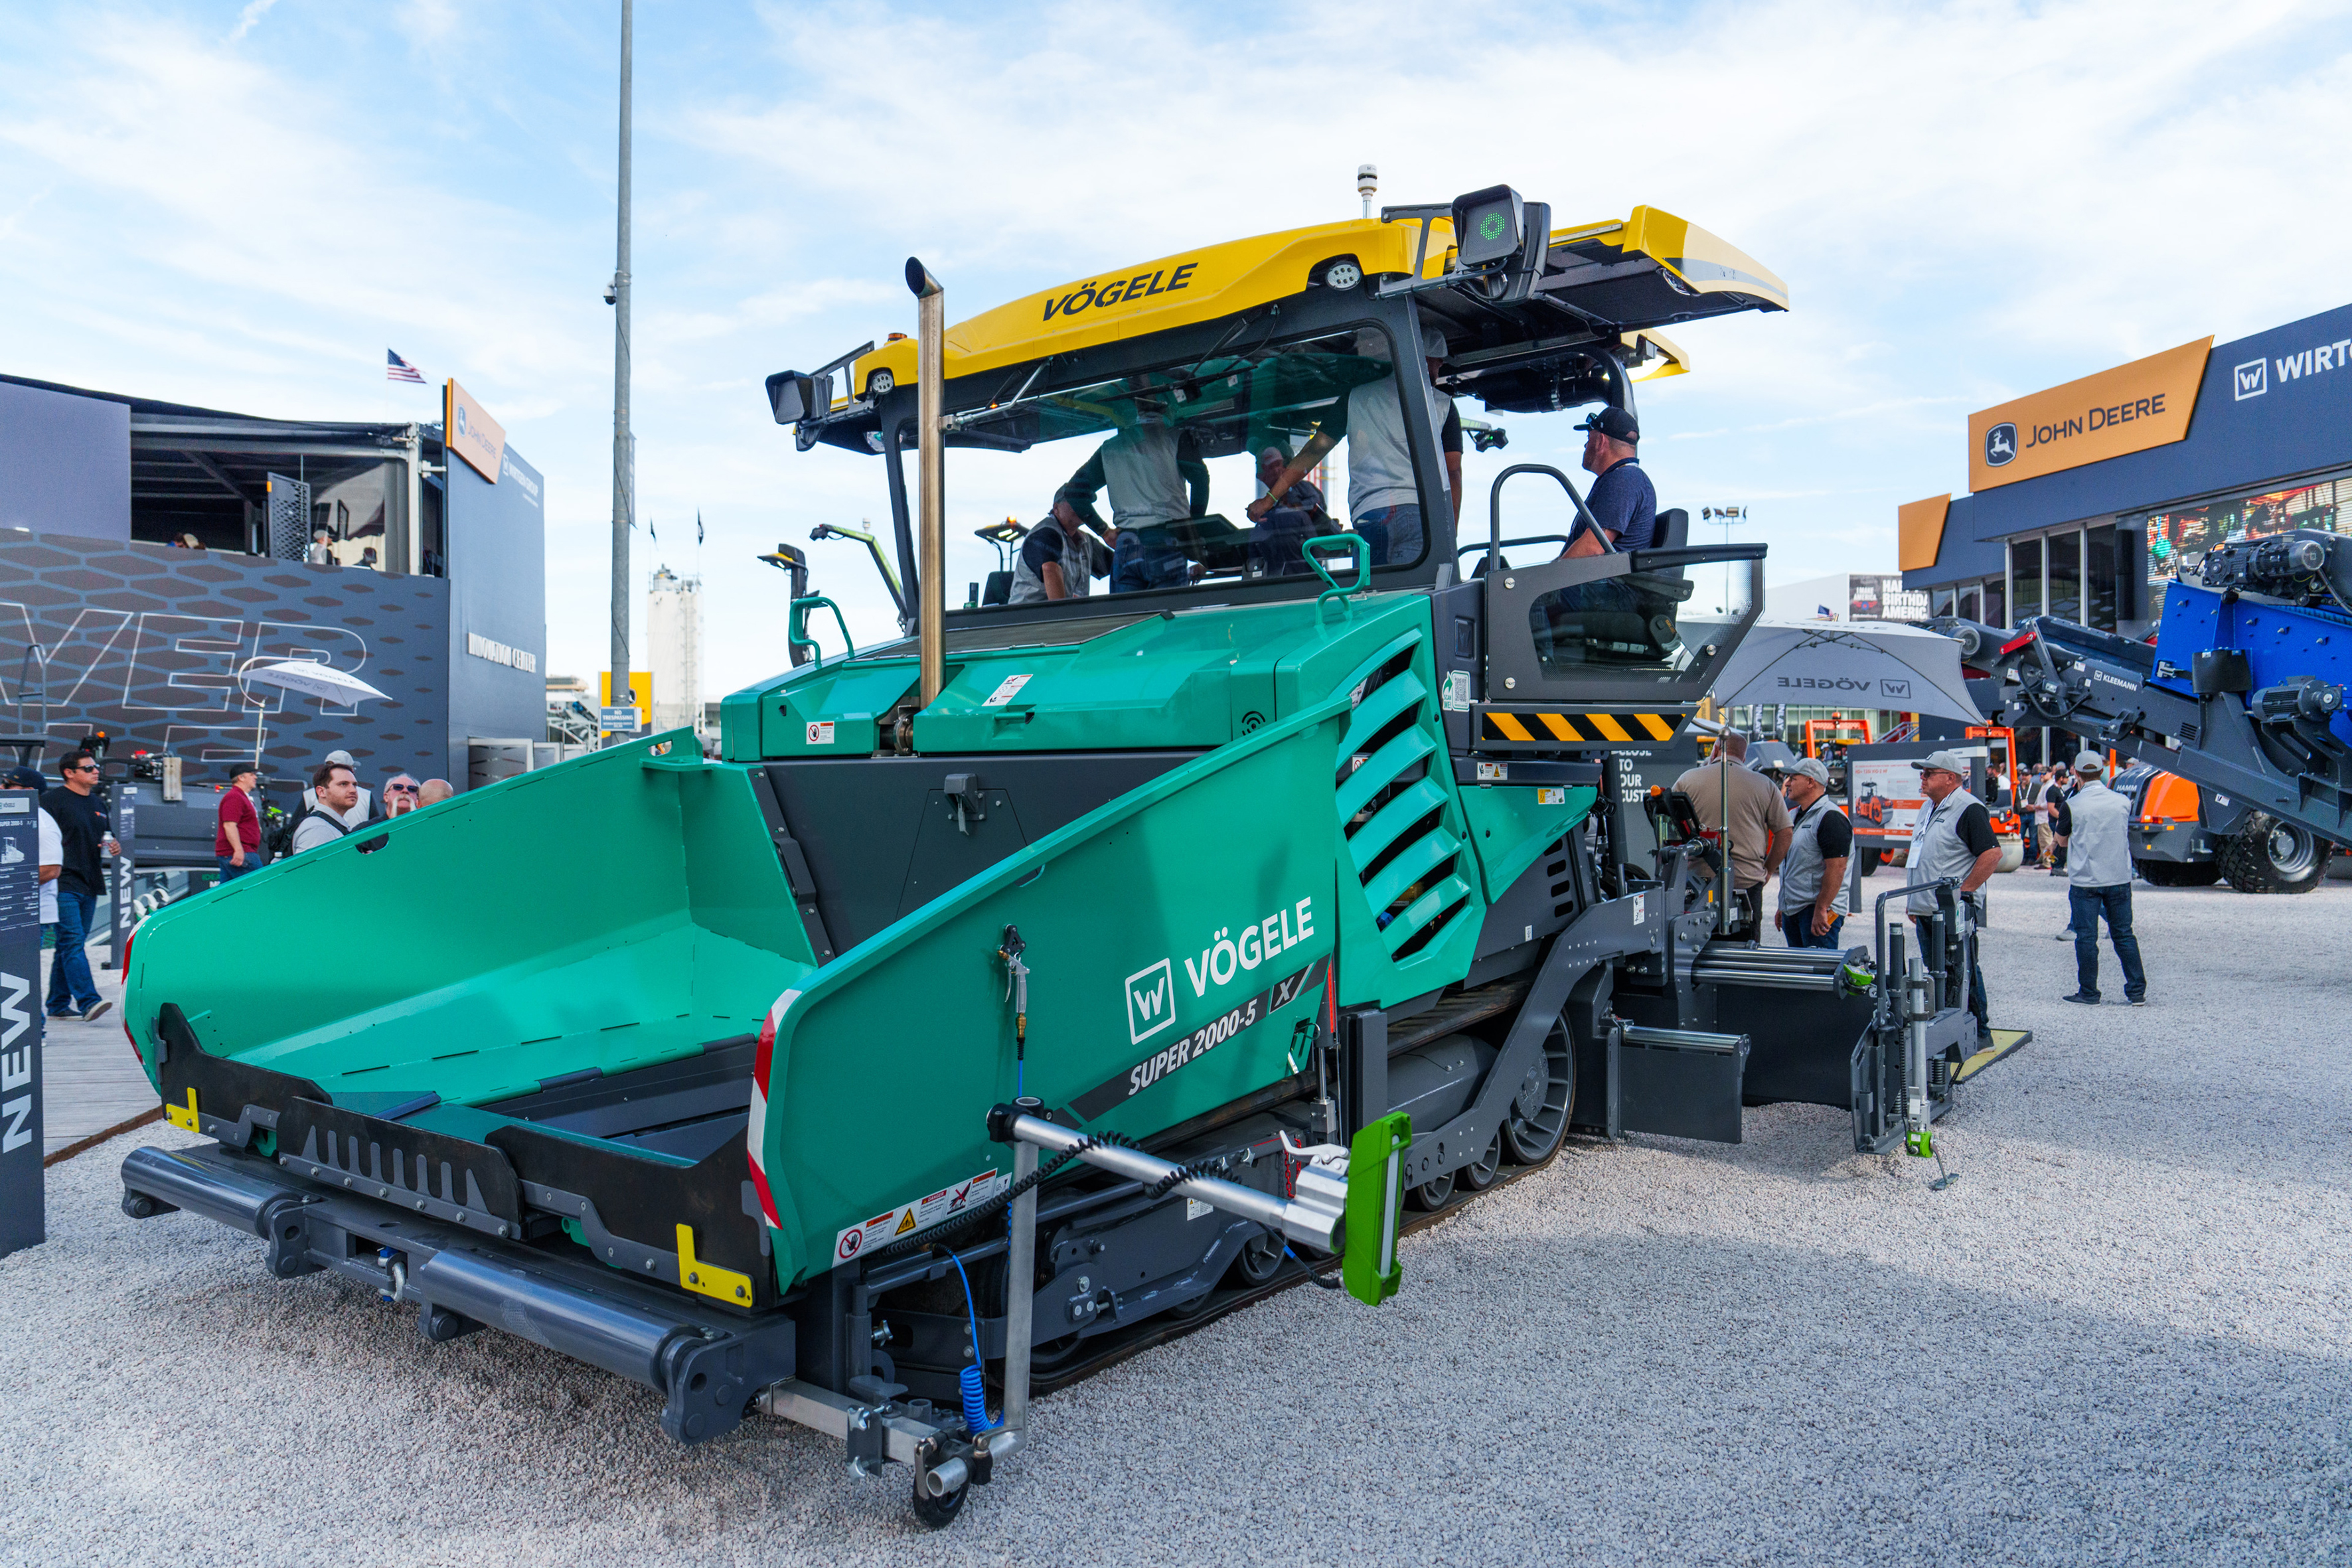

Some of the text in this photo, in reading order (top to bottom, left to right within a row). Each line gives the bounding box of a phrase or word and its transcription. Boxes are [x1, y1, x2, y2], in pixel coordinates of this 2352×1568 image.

[1042, 262, 1199, 321] VÖGELE
[2275, 338, 2352, 383] WIRT
[2025, 393, 2165, 449] JOHN DEERE
[1881, 605, 1928, 619] AMERIC
[468, 631, 536, 673] INNOVATION CENTER
[2102, 674, 2138, 692] KLEEMANN
[1618, 758, 1634, 772] TO
[120, 856, 131, 929] NEW
[1184, 896, 1315, 997] VÖGELE
[1128, 975, 1295, 1096] SUPER 2000-5 X
[1, 972, 33, 1154] NEW
[927, 1191, 945, 1202] DANGER
